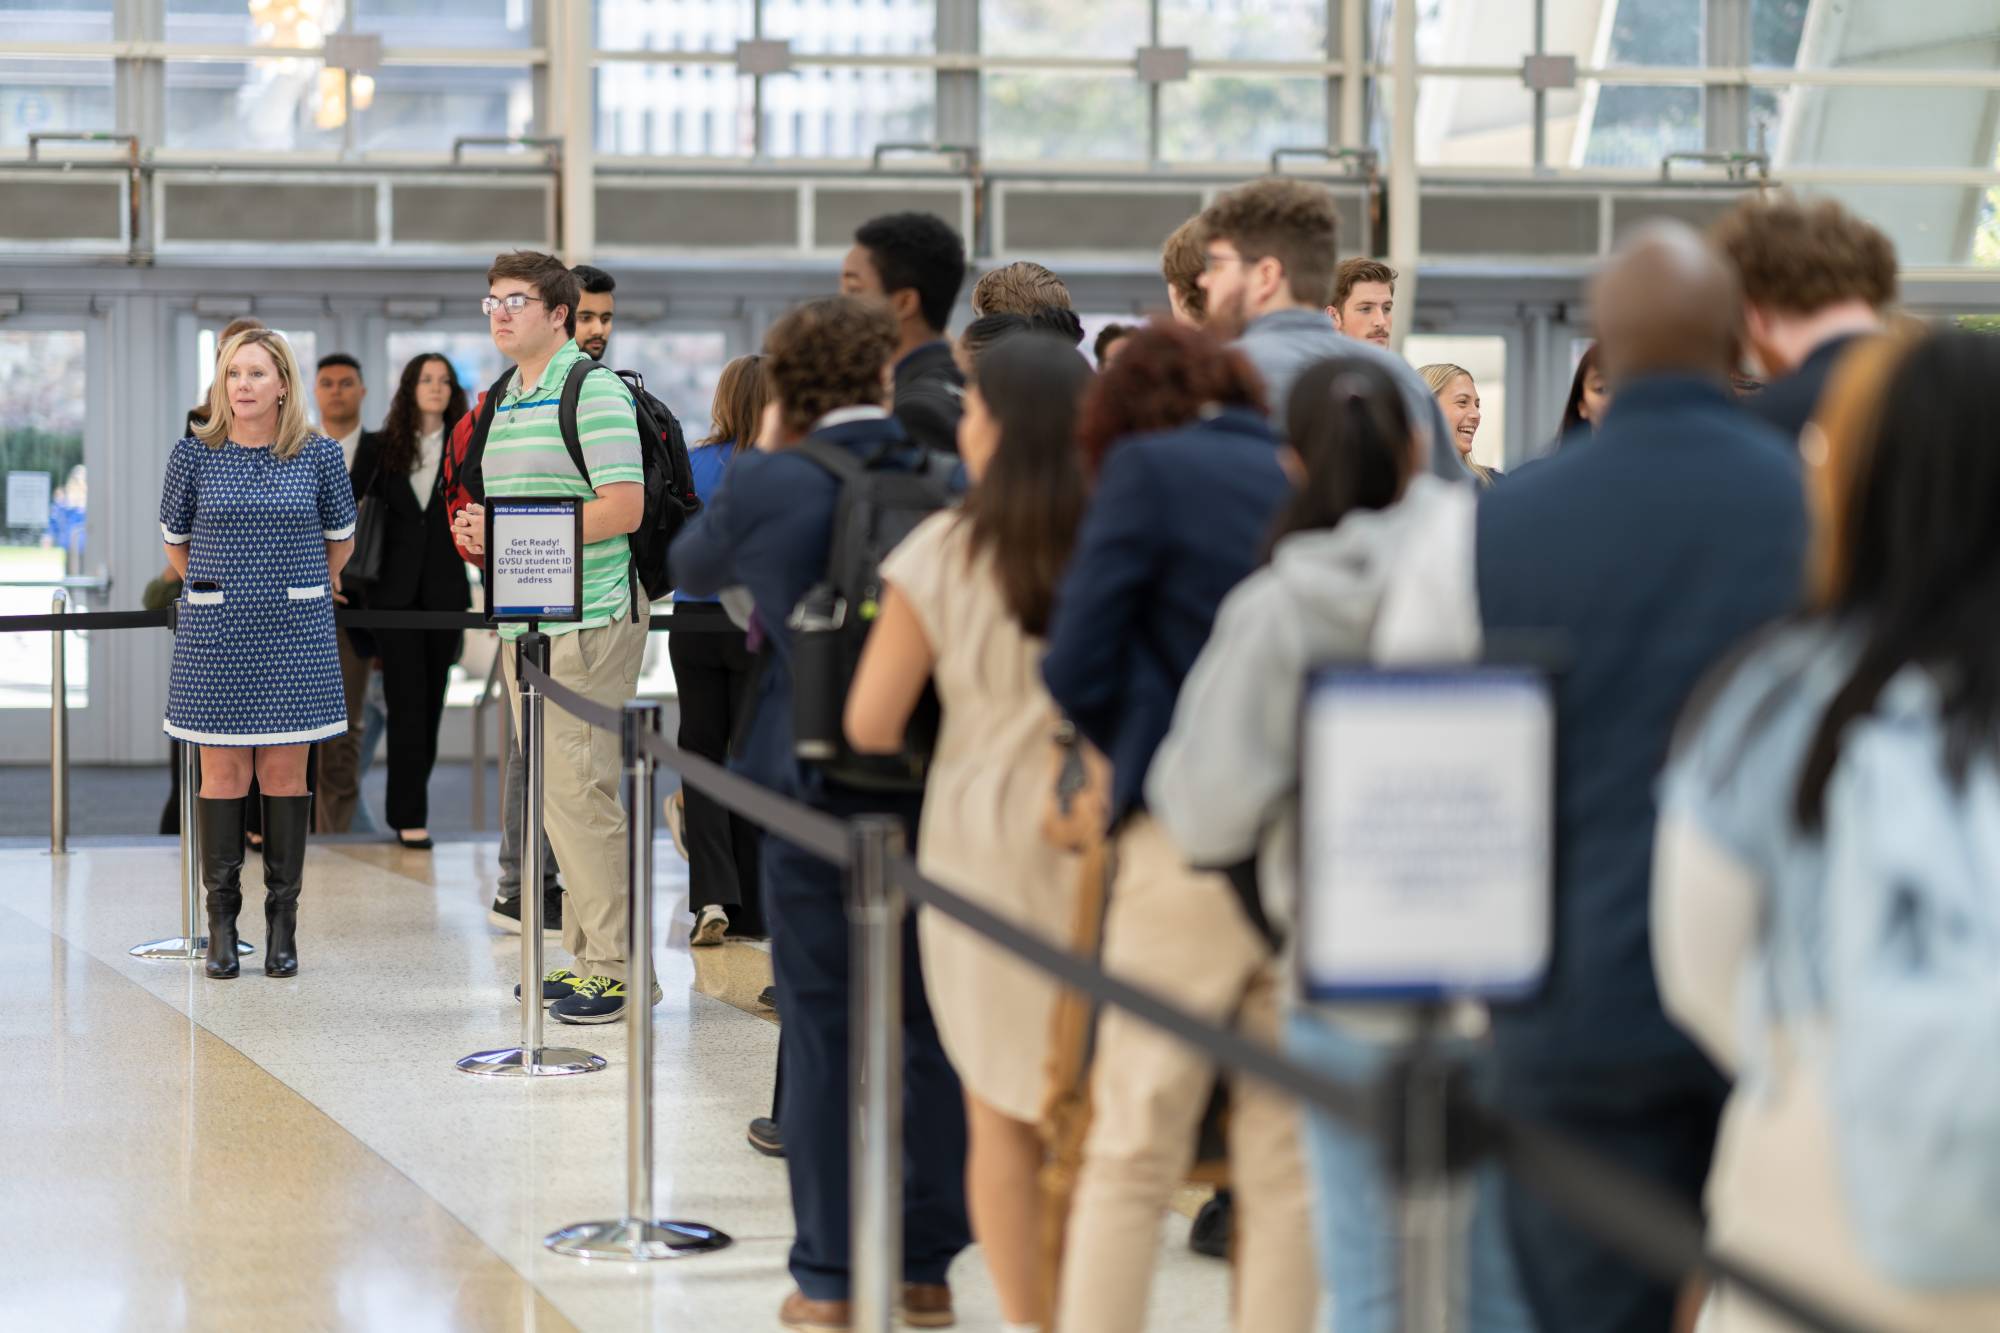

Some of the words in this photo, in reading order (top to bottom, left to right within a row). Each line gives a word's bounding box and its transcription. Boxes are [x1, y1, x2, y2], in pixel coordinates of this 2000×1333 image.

[529, 538, 560, 548] Ready!
[498, 557, 523, 565] GVSU
[525, 557, 560, 565] student
[562, 557, 572, 565] ID
[510, 567, 545, 575] student
[547, 566, 572, 575] email
[517, 576, 553, 584] address
